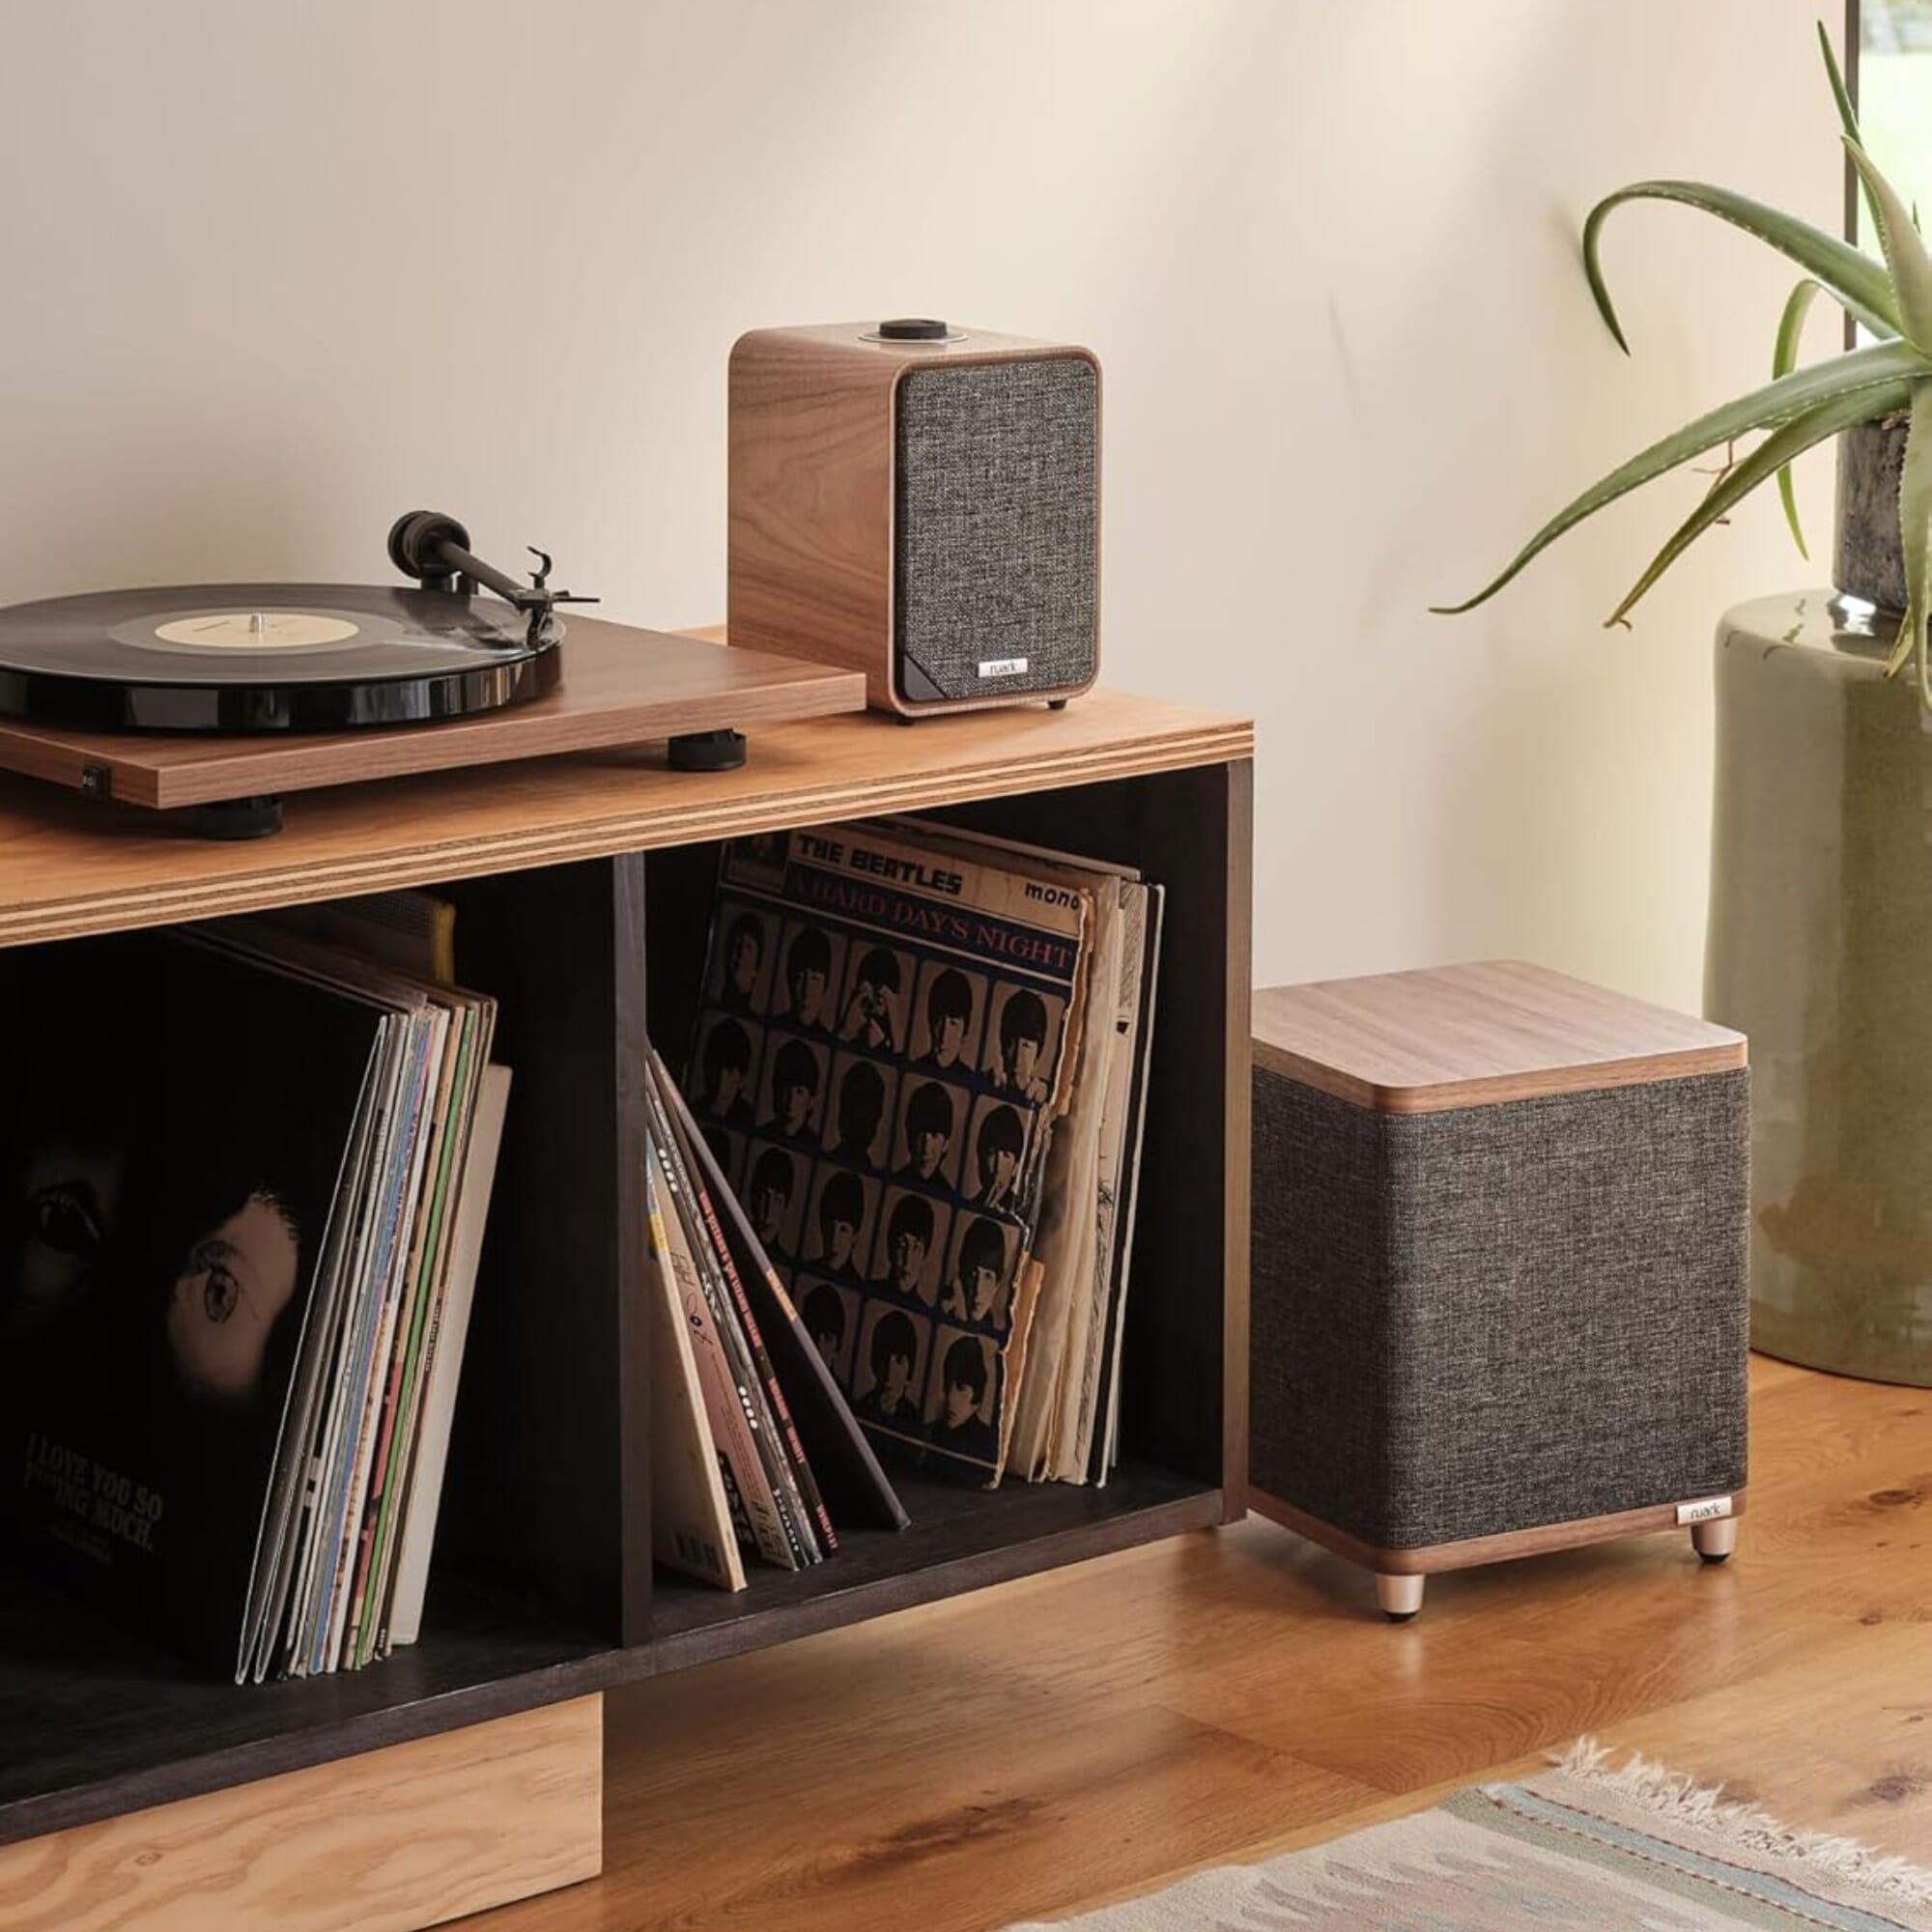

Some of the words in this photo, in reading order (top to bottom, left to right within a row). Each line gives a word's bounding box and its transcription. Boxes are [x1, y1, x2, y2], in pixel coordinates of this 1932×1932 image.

[799, 834, 842, 864] THE
[850, 848, 962, 895] BEATLES
[817, 878, 885, 915] HARD
[891, 901, 970, 940] DAY'S
[976, 923, 1073, 969] NIGHT
[1024, 882, 1080, 910] mono
[38, 1434, 90, 1486] LOVE
[92, 1460, 130, 1506] YOU
[133, 1486, 162, 1522] SO
[1690, 1502, 1720, 1520] ruark
